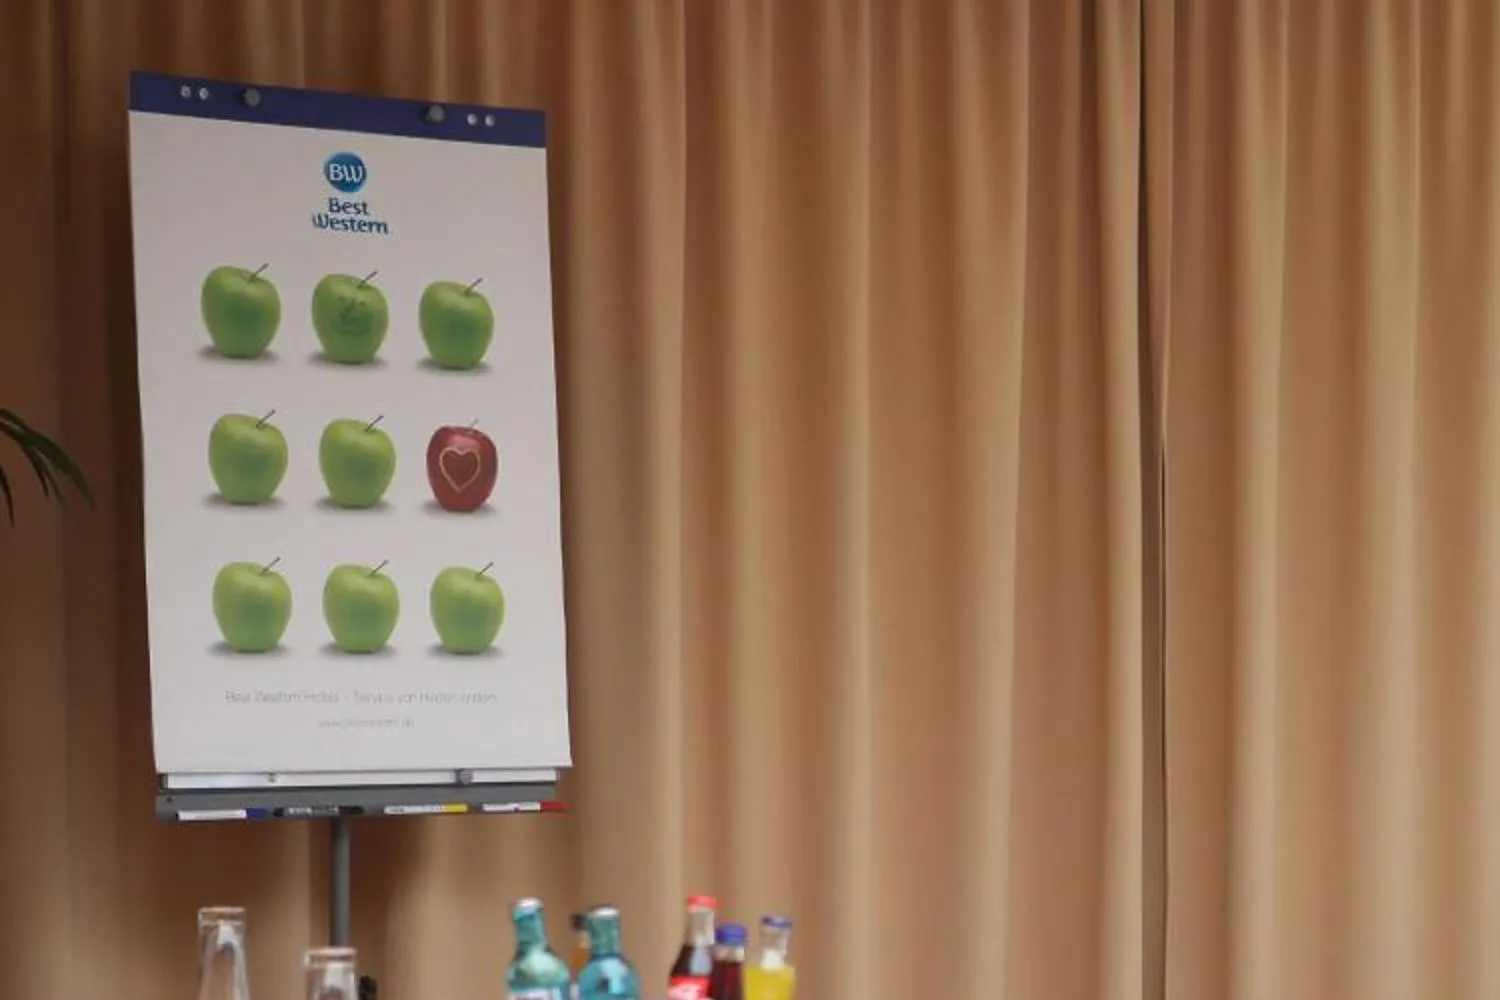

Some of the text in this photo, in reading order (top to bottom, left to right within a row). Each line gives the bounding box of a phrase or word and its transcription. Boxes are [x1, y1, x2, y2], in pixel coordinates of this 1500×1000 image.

[329, 163, 363, 183] BW
[328, 197, 369, 215] Best
[312, 213, 389, 234] Western
